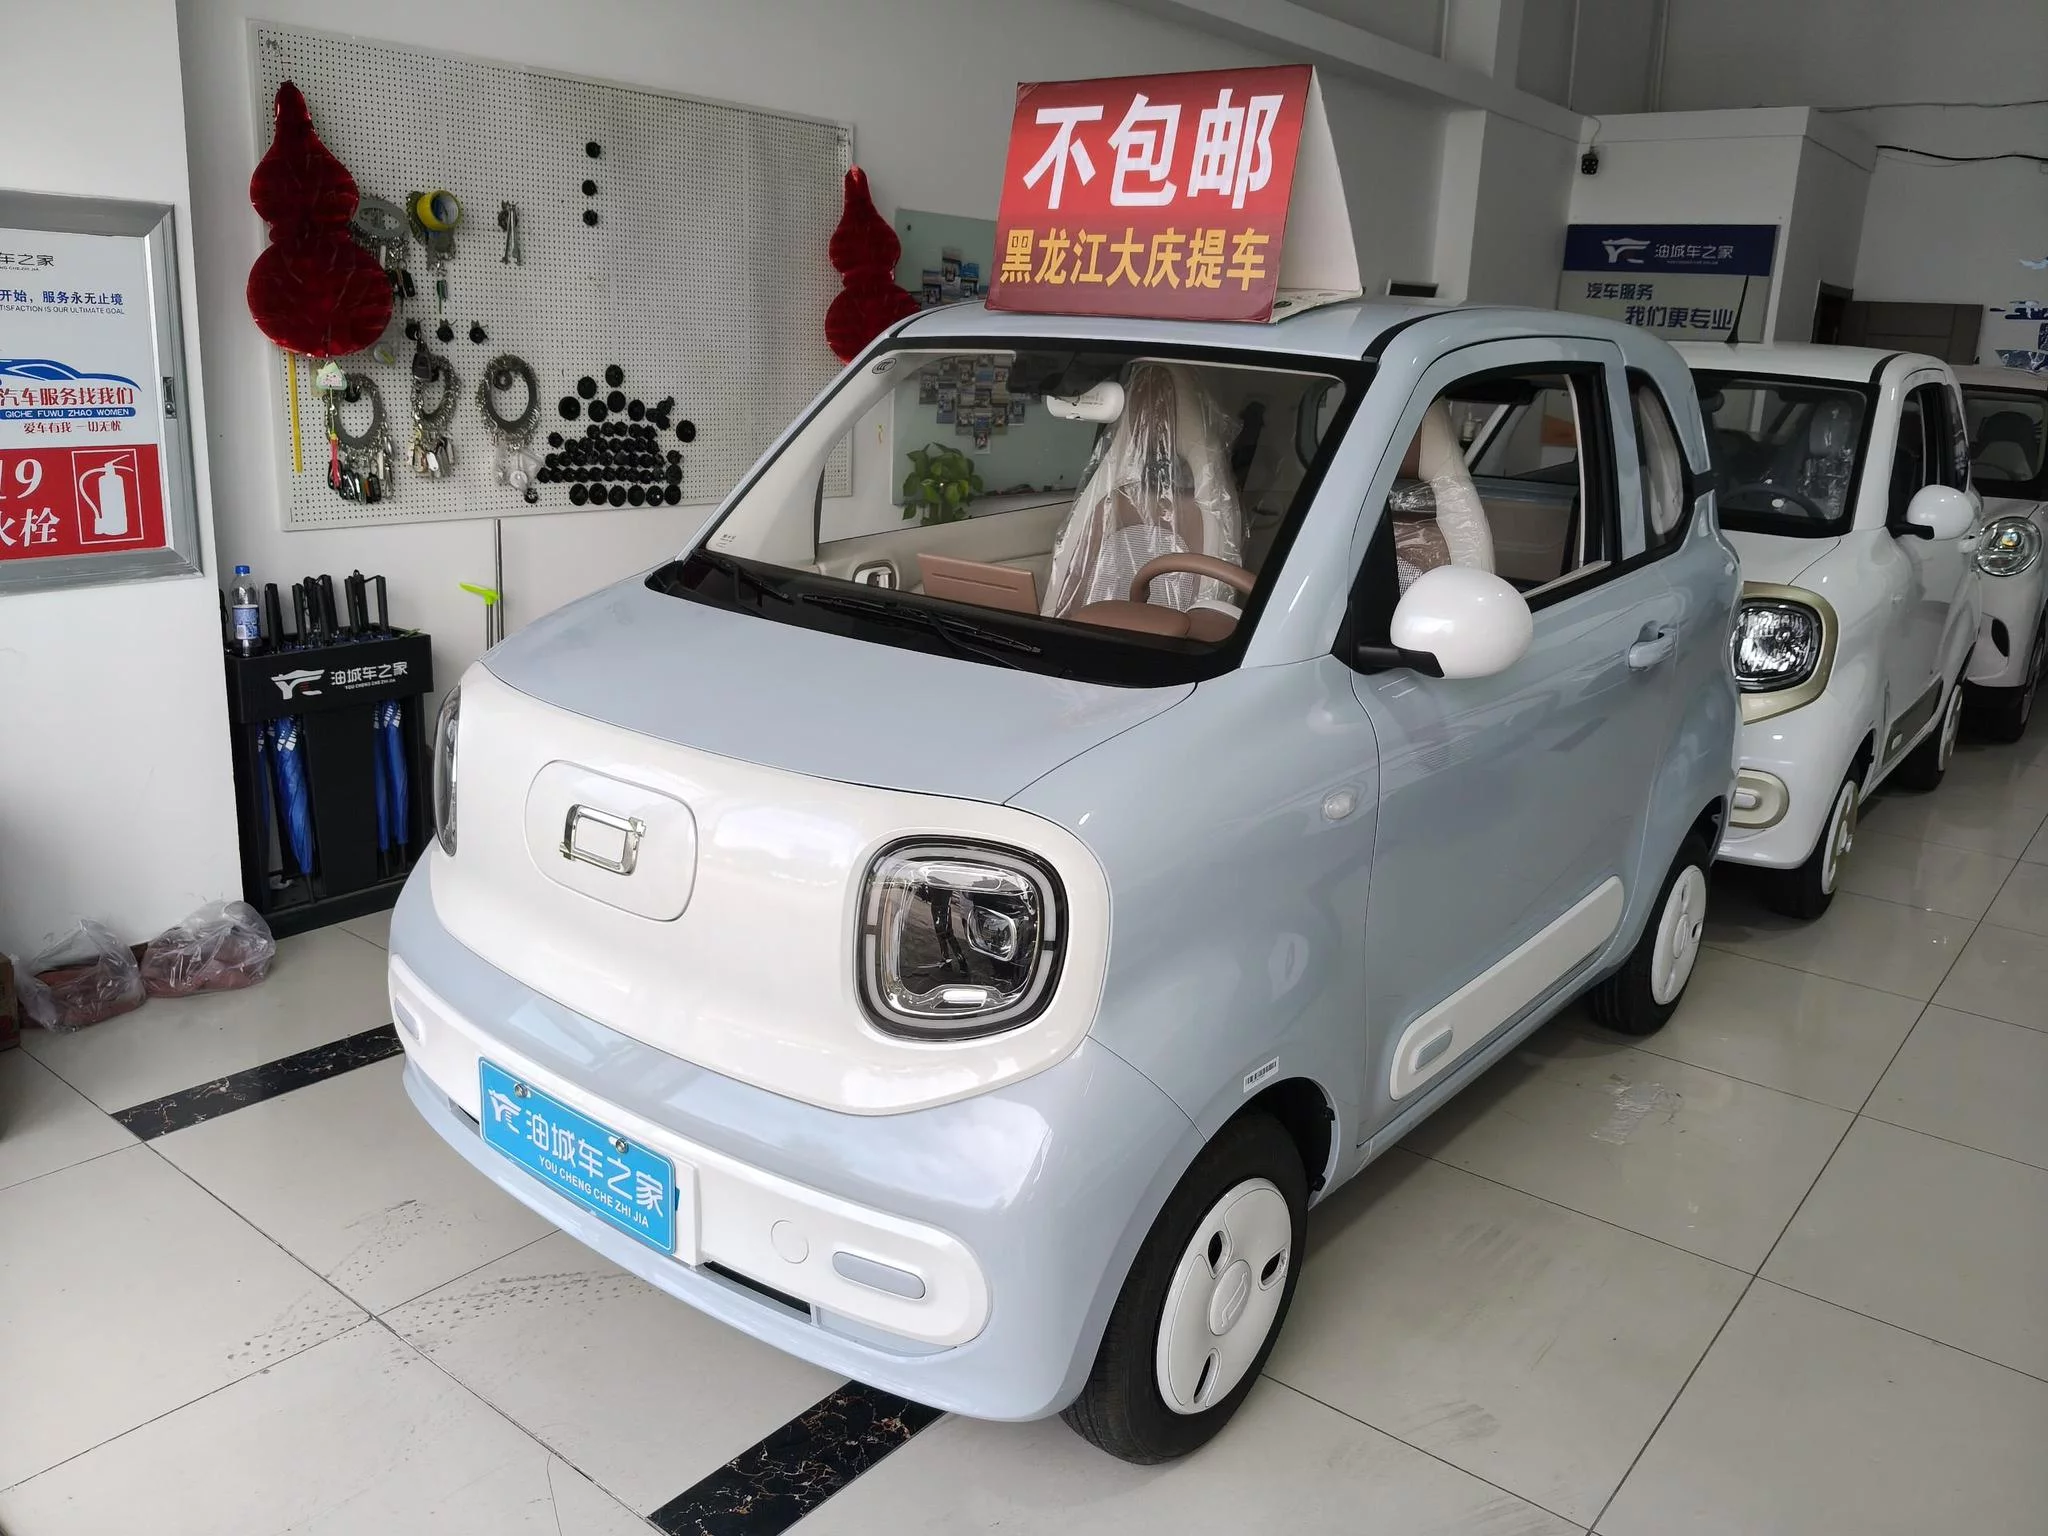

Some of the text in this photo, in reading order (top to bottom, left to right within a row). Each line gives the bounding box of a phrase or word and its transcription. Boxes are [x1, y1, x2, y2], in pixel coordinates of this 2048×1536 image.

[1022, 88, 1285, 210] 不包邮
[999, 227, 1270, 291] 黑龙江大庆提车
[1654, 244, 1734, 259] 油城车之家
[1586, 282, 1653, 300] 汽车服务
[70, 306, 105, 314] ULTIMATE
[1625, 305, 1734, 331] 我们更专业
[5, 408, 129, 418] QICHE FUWU ZHAO WOMEN
[24, 421, 122, 434] 爱车有我 一切无忧
[330, 661, 408, 685] 油城车之家
[525, 1109, 664, 1218] 油城车之家
[539, 1155, 649, 1228] YOU CHENG CHE ZHI JIA
